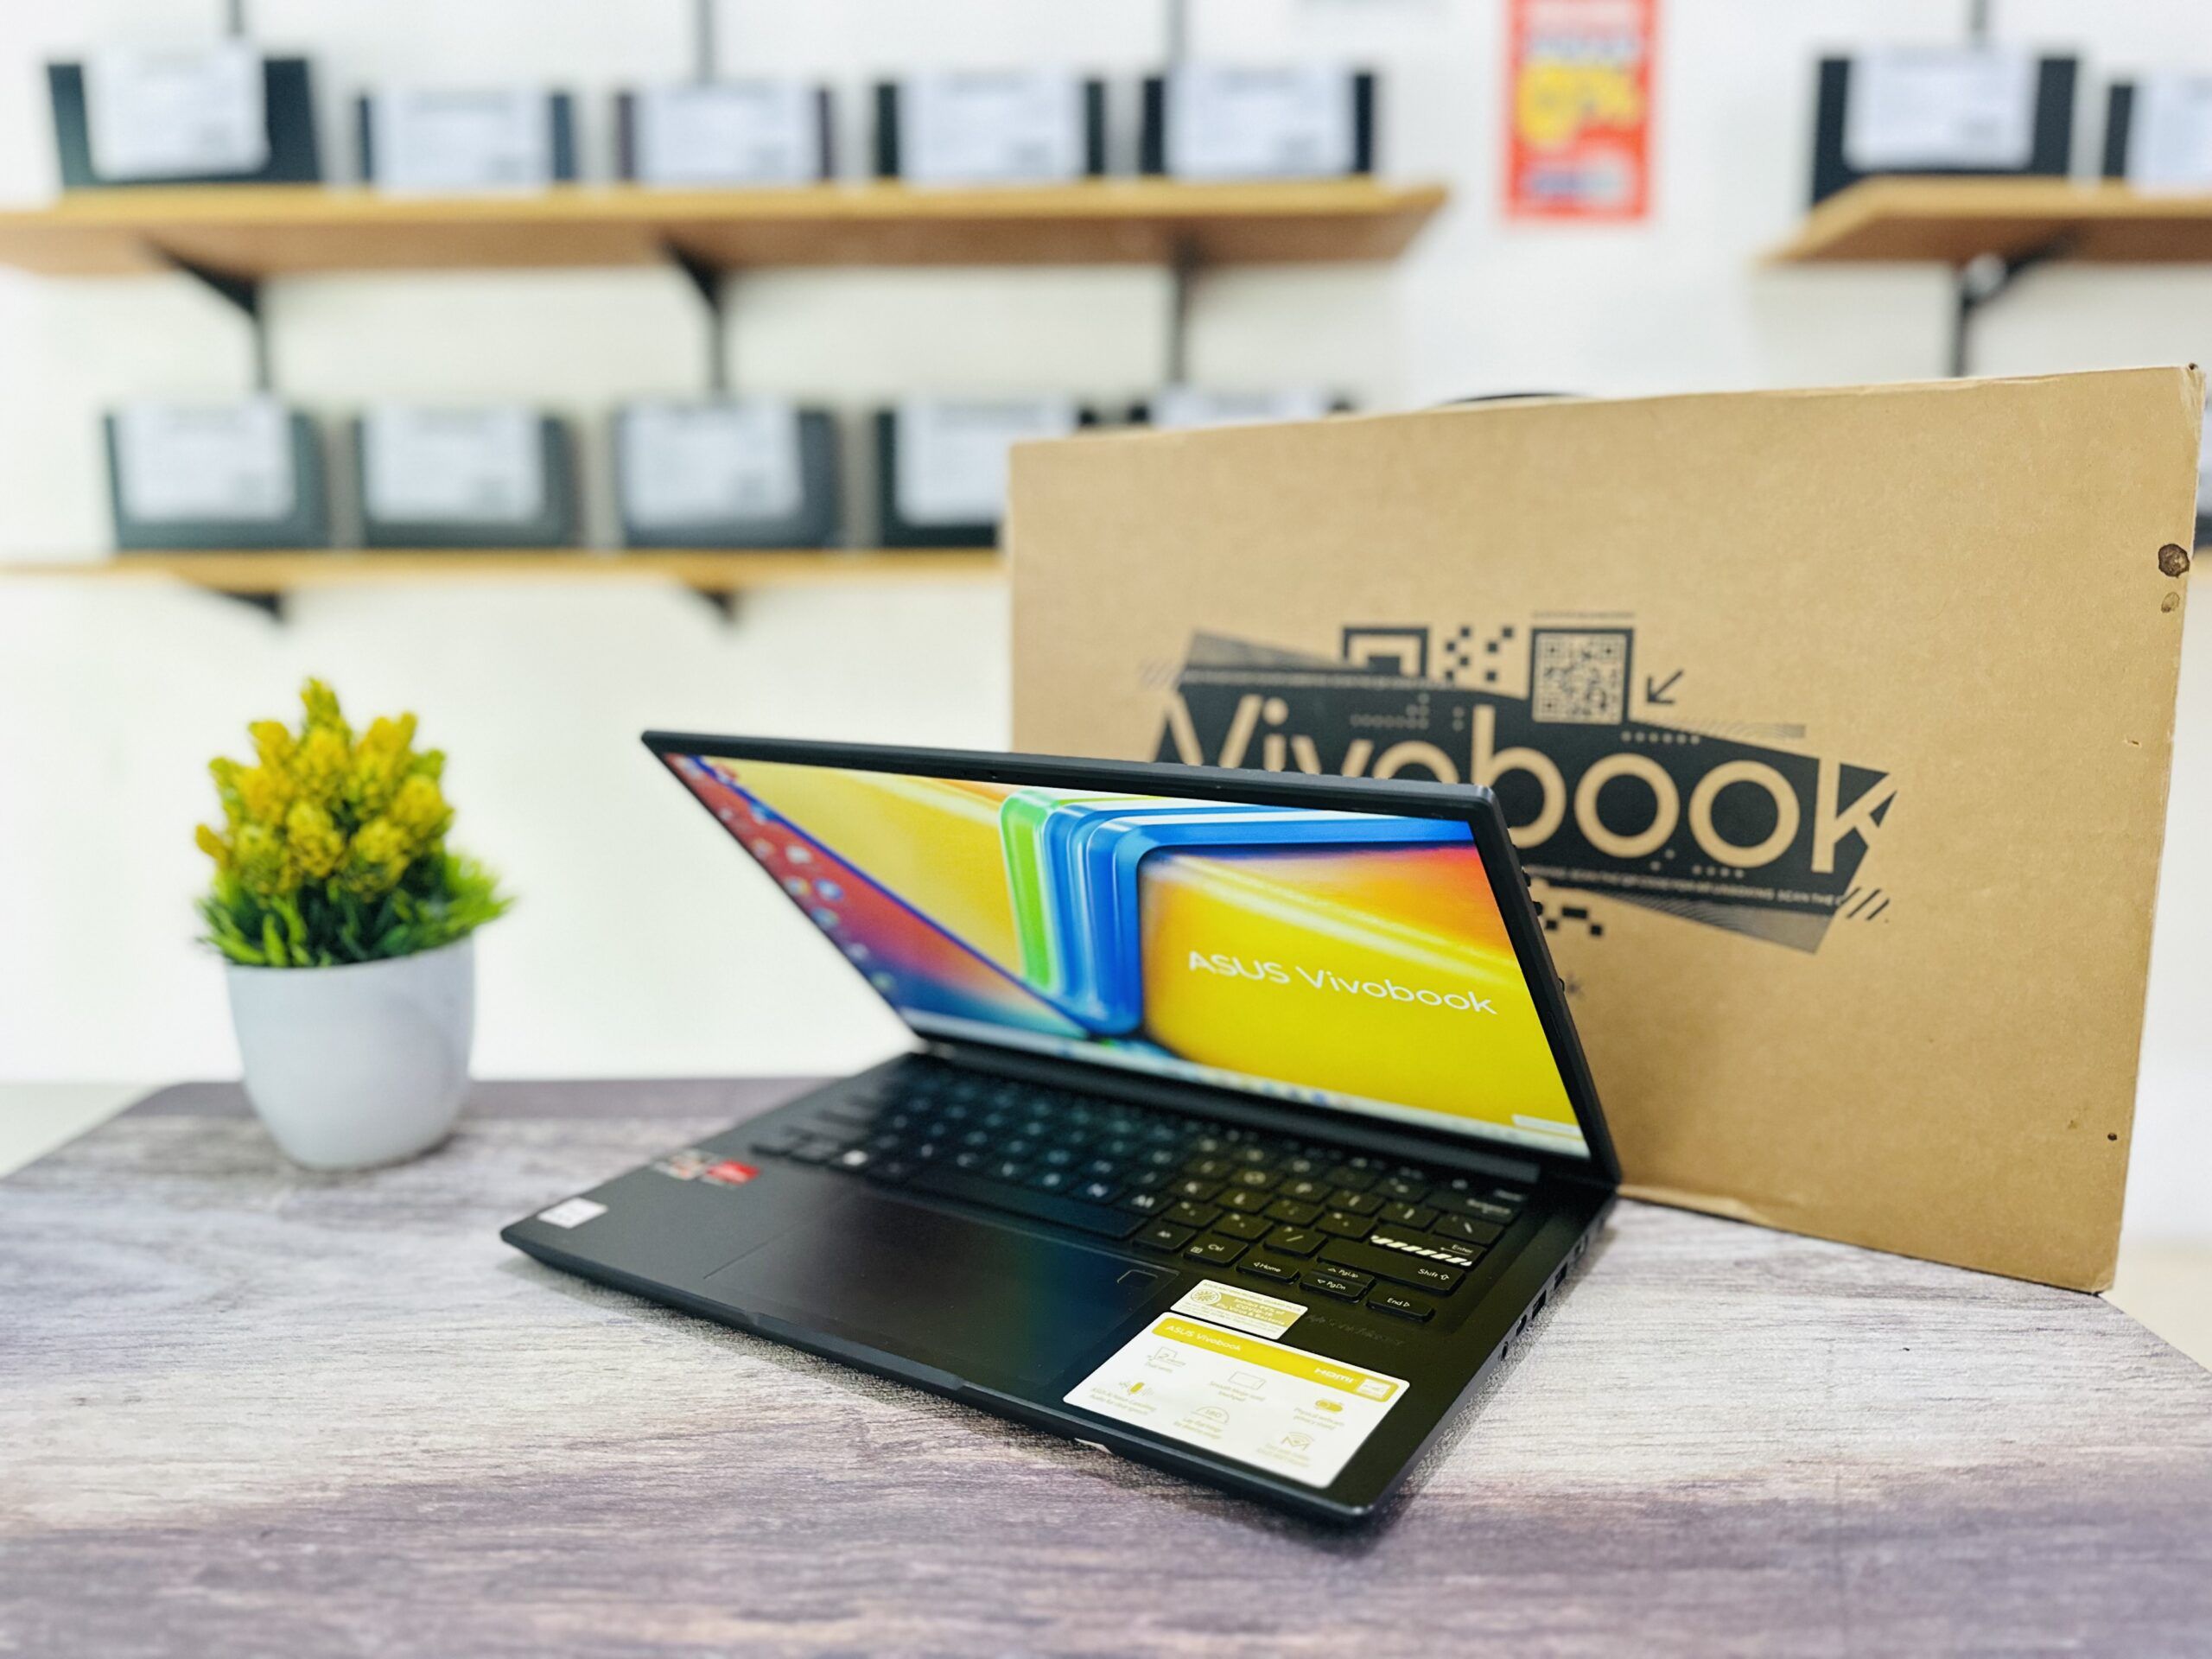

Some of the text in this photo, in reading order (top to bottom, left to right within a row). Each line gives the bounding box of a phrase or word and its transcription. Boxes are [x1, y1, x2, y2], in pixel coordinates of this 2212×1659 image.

[1188, 950, 1498, 1015] ASUS Vivobook
[1452, 1244, 1473, 1254] Enter
[1259, 1262, 1281, 1273] Home
[1418, 1268, 1439, 1278] Shift
[1338, 1268, 1359, 1279] PgUp
[1325, 1280, 1346, 1291] PgDn
[1387, 1297, 1403, 1307] End
[1166, 1325, 1243, 1352] ASUS Vivobook
[1314, 1367, 1355, 1383] HDMI
